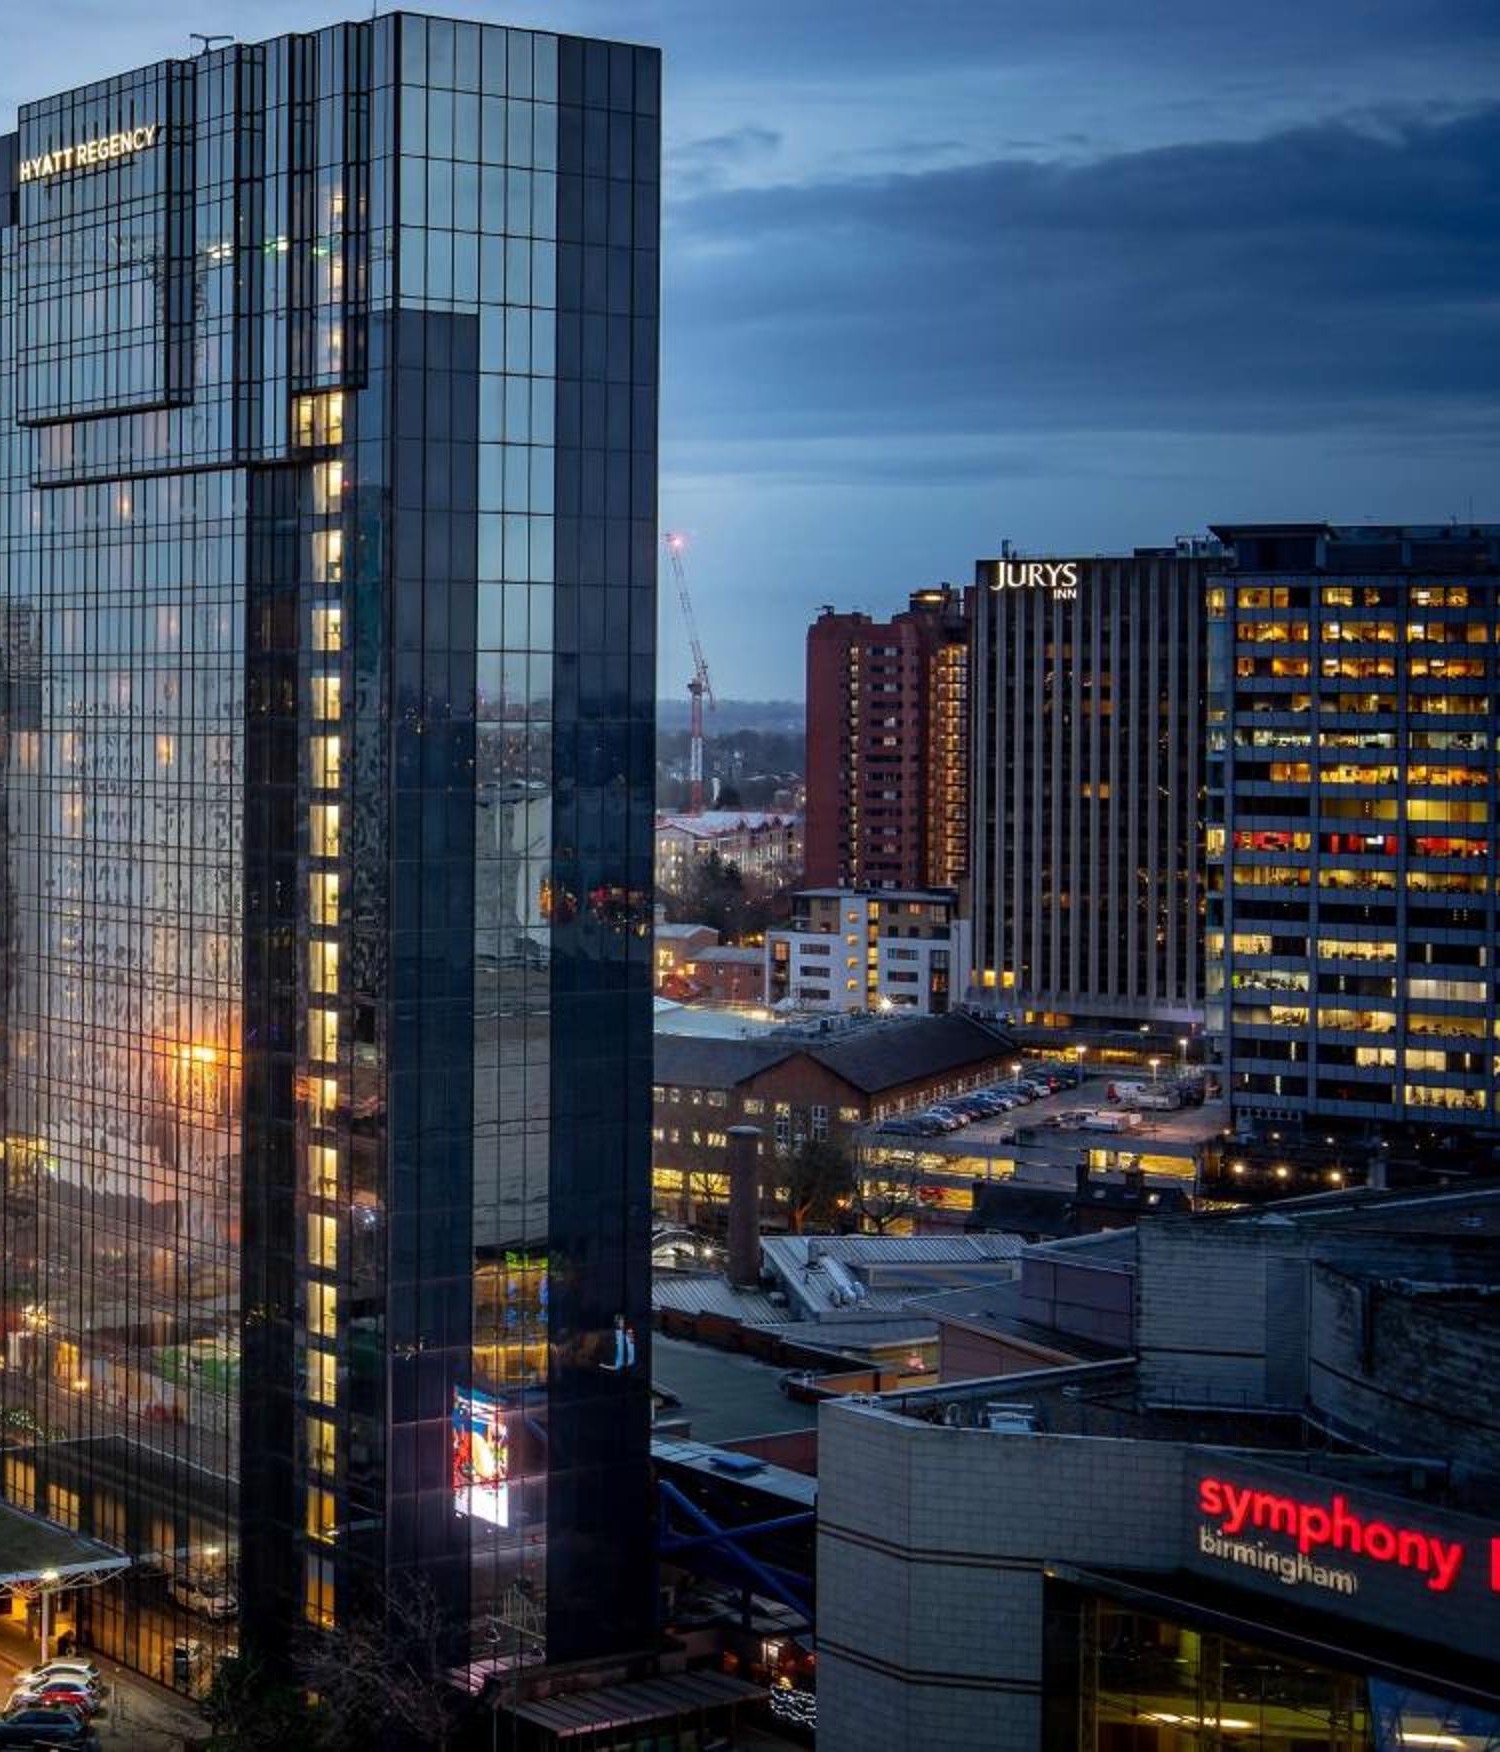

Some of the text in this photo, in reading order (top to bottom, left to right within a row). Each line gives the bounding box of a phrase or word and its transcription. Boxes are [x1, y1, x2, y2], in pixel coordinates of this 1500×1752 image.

[20, 123, 156, 182] HYATT REGENCY
[989, 561, 1077, 591] JURYS
[1053, 588, 1077, 599] INN
[1199, 1477, 1463, 1591] symphony
[1200, 1525, 1357, 1595] birmingham
